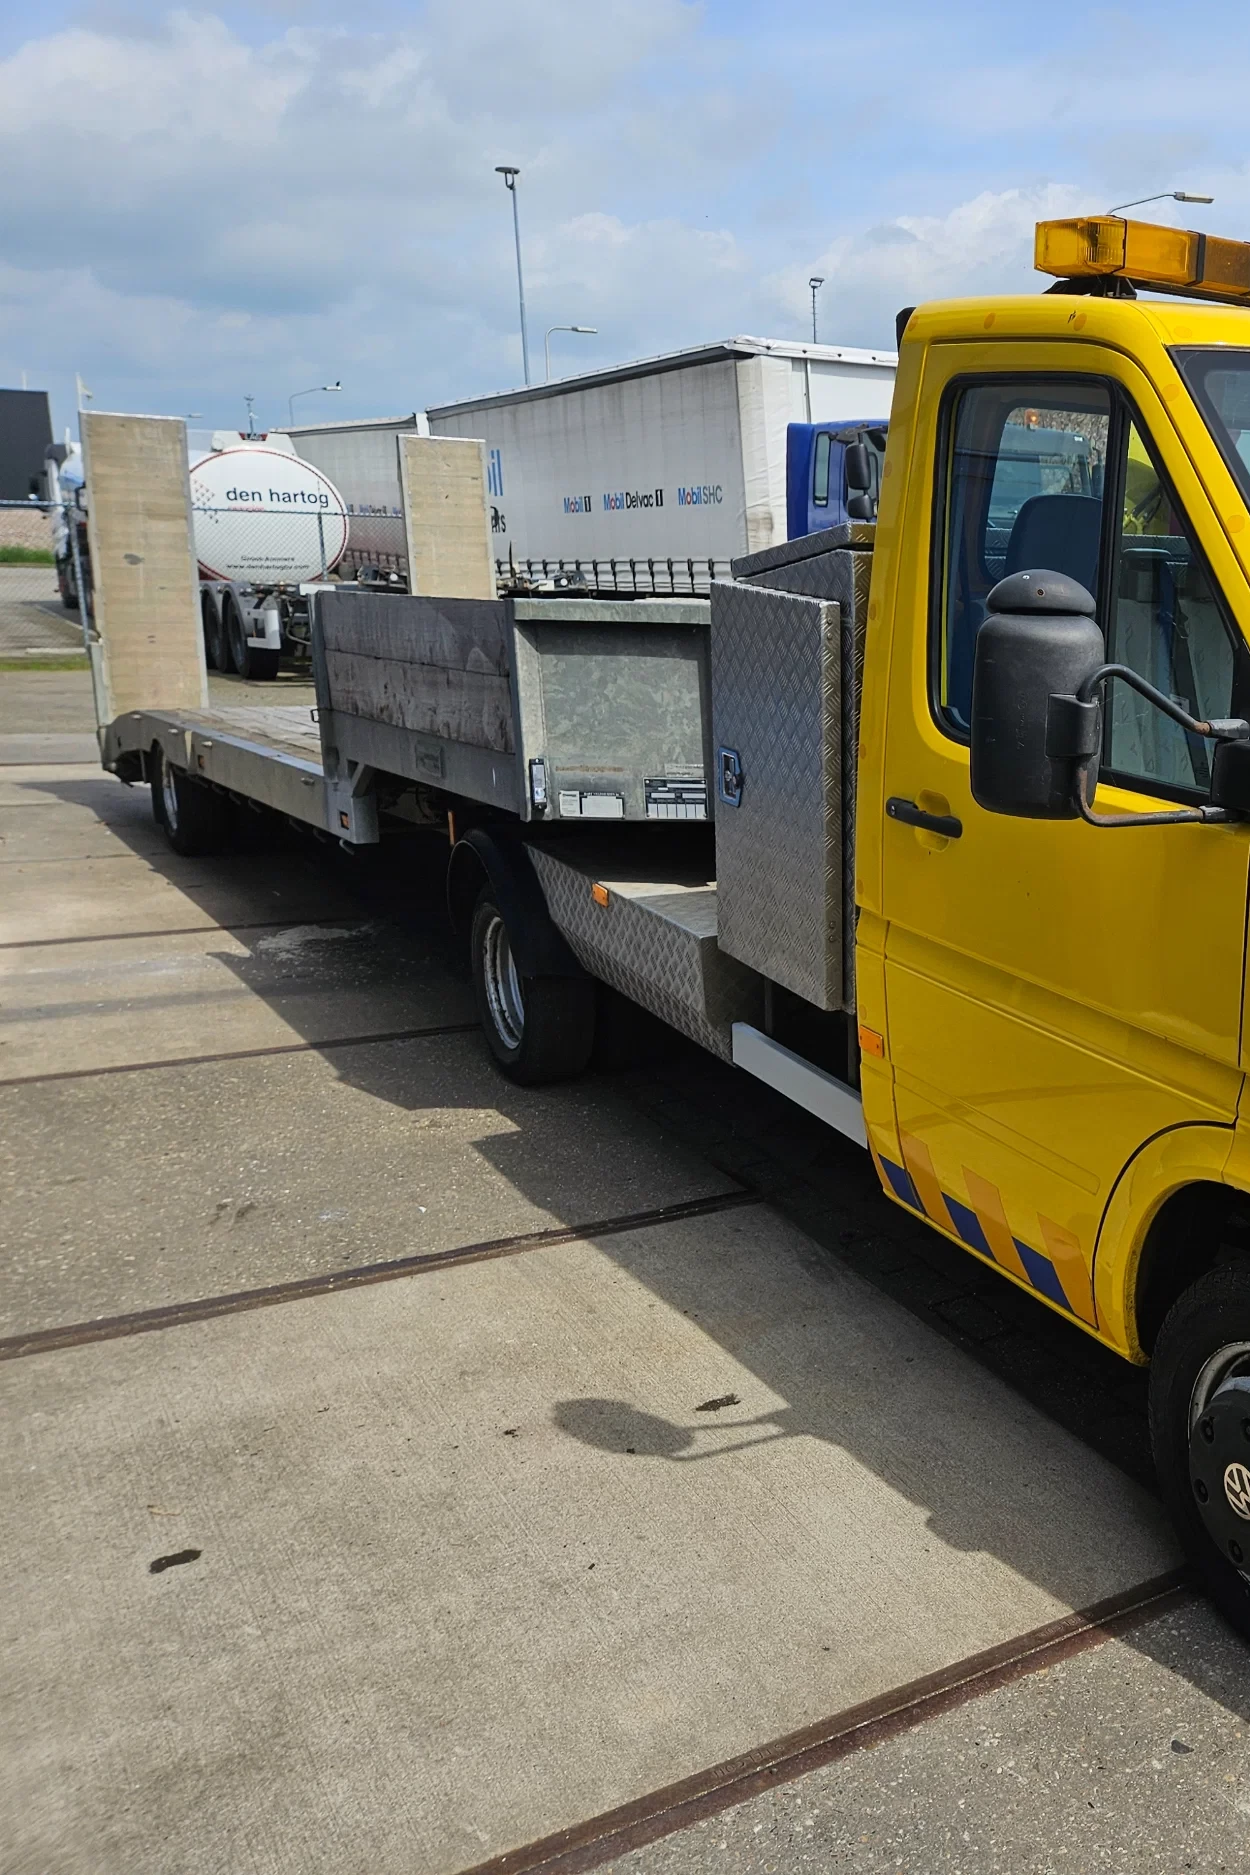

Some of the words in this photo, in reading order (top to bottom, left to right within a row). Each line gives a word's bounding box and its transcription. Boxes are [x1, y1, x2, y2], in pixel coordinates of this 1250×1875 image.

[226, 487, 262, 502] den
[269, 488, 329, 508] hartog
[563, 496, 583, 513] Mobil
[603, 492, 624, 511] Mobil
[625, 491, 654, 509] Delvac
